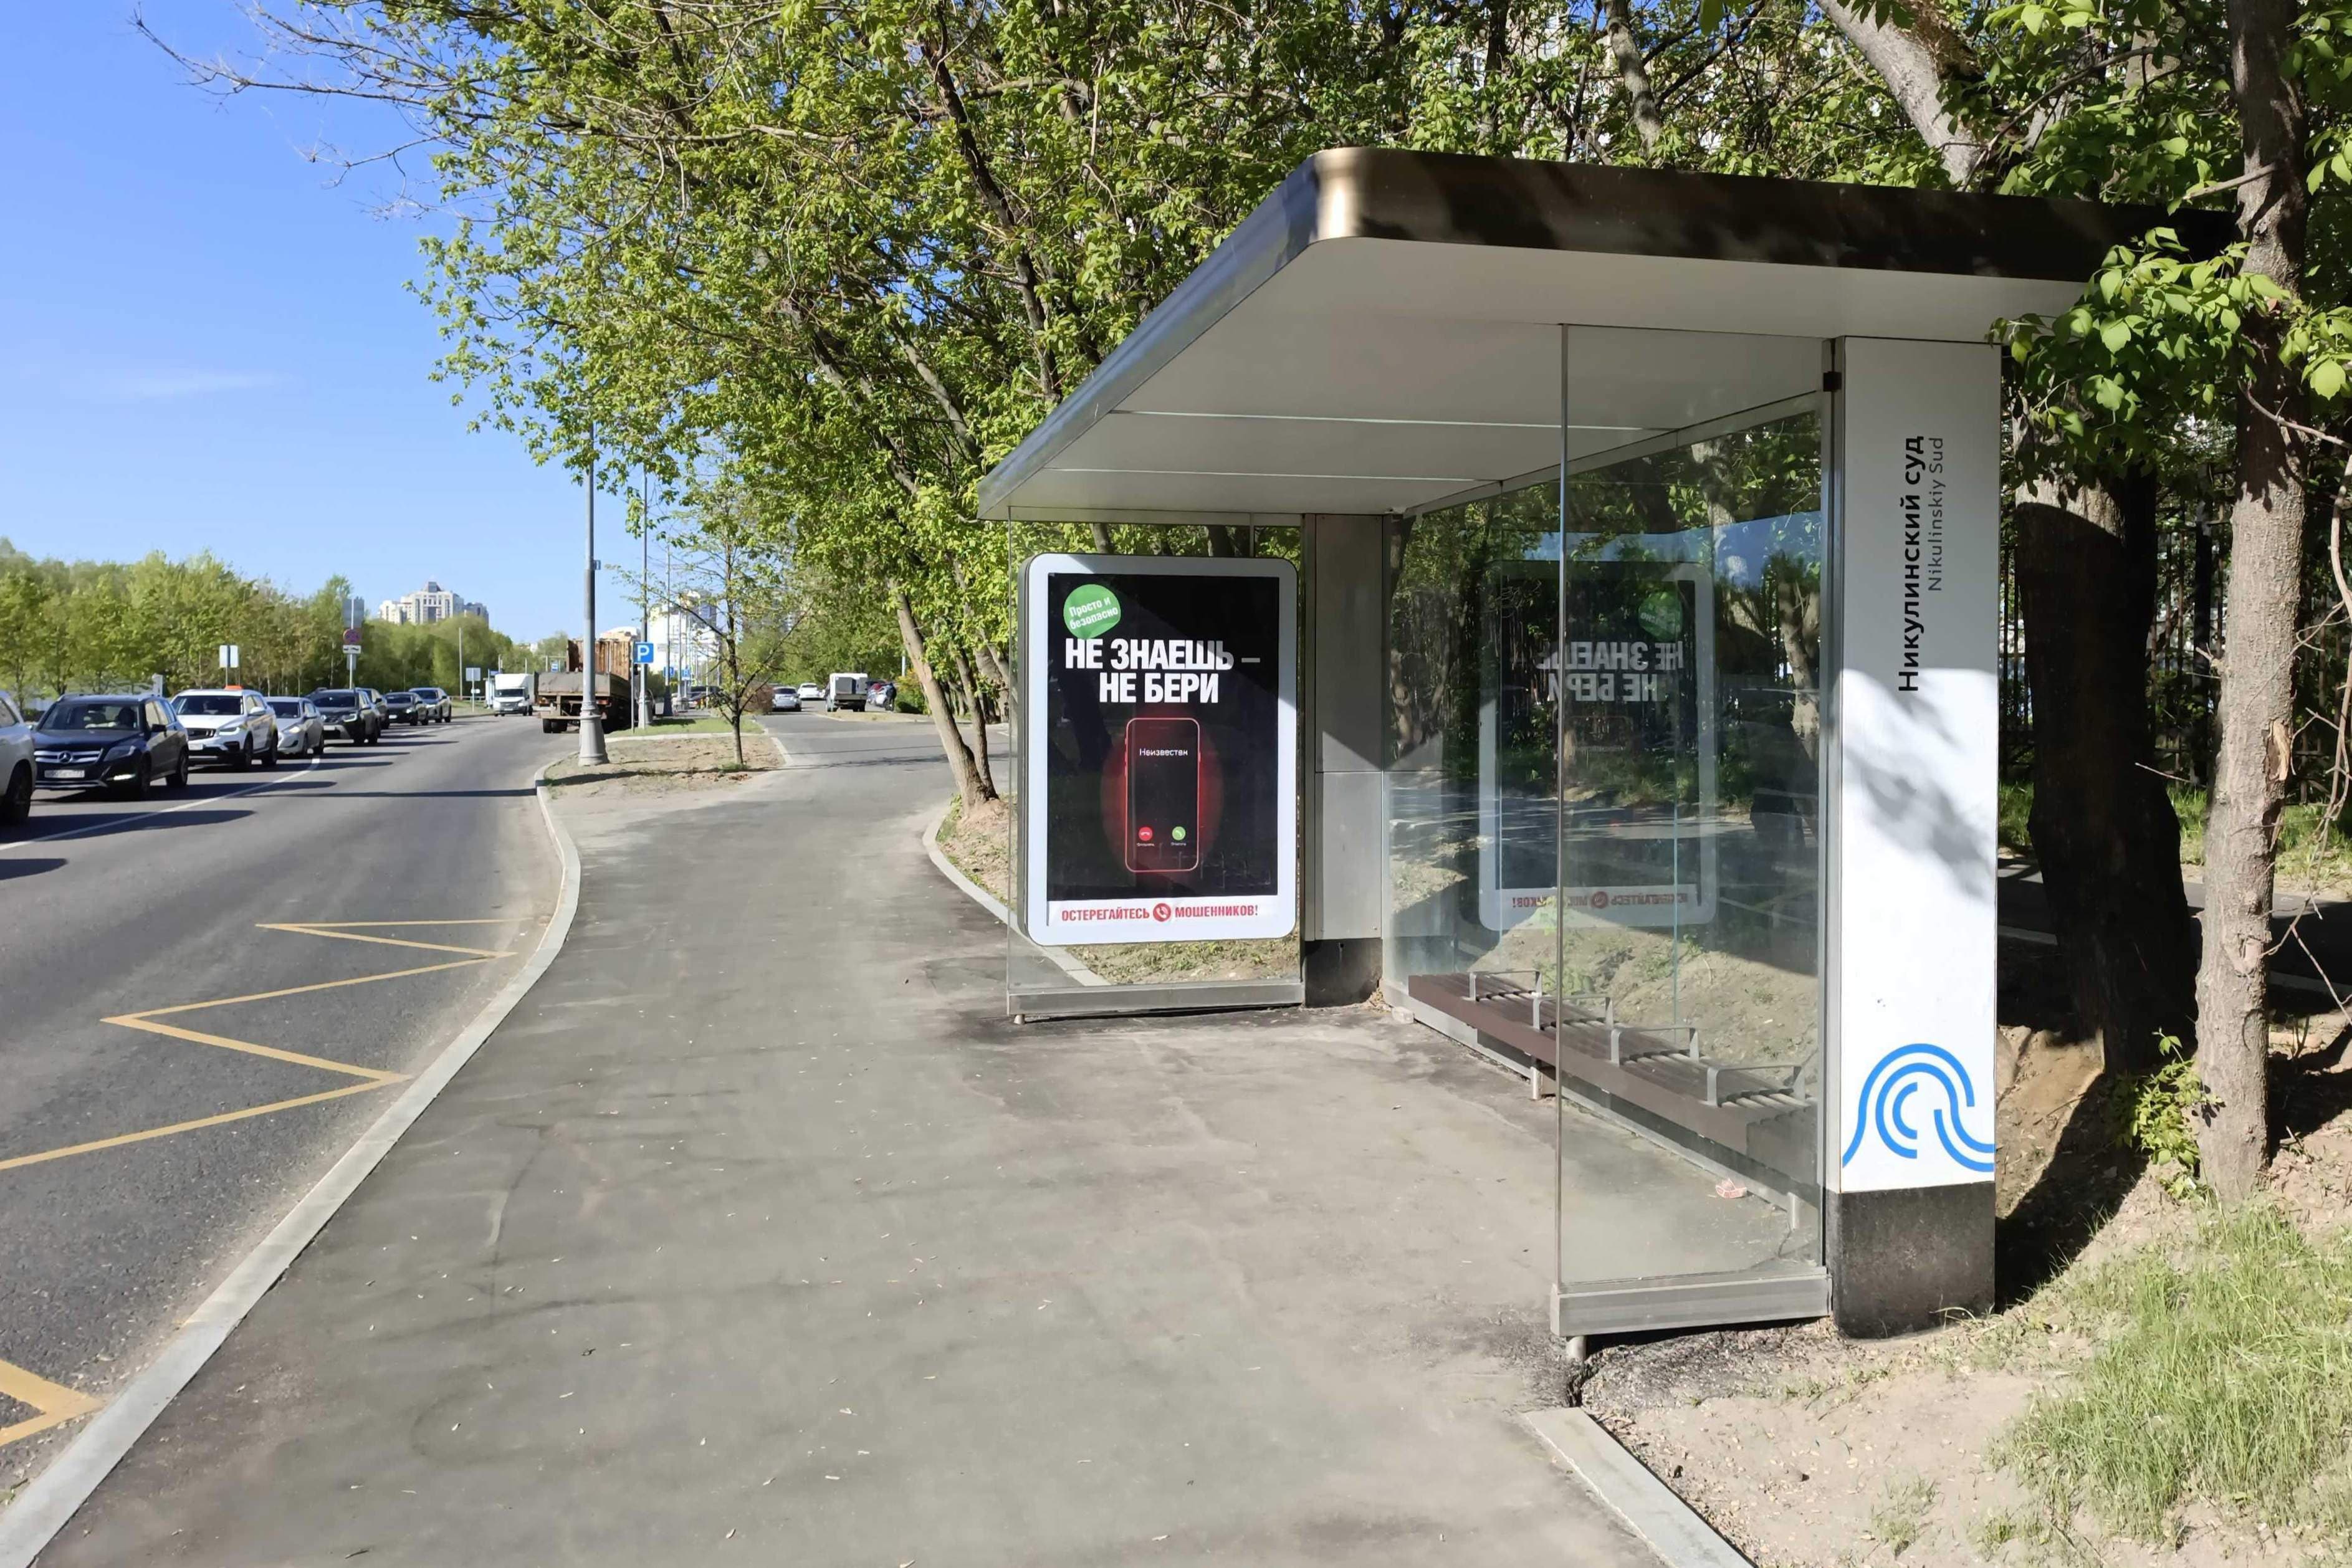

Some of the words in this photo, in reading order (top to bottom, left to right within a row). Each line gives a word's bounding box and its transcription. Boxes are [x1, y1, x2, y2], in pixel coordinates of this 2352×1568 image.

[1905, 436, 1926, 485] суд
[1928, 437, 1943, 474] Sud
[1927, 479, 1946, 591] Nikulinskiy
[1069, 600, 1102, 617] Просто
[1103, 596, 1111, 606] и
[1898, 495, 1924, 691] Никулинский
[1069, 607, 1119, 629] безопасно
[637, 644, 649, 662] P
[1065, 638, 1103, 669] НЕ
[1110, 638, 1235, 671] ЗНАЕШЬ
[1099, 672, 1137, 702] НЕ
[1144, 672, 1219, 704] БЕРИ
[1139, 748, 1188, 757] Неизвестен
[1062, 907, 1150, 922] ОСТЕРЕГАЙТЕСЬ
[1175, 904, 1258, 919] МОШЕННИКОВ!
